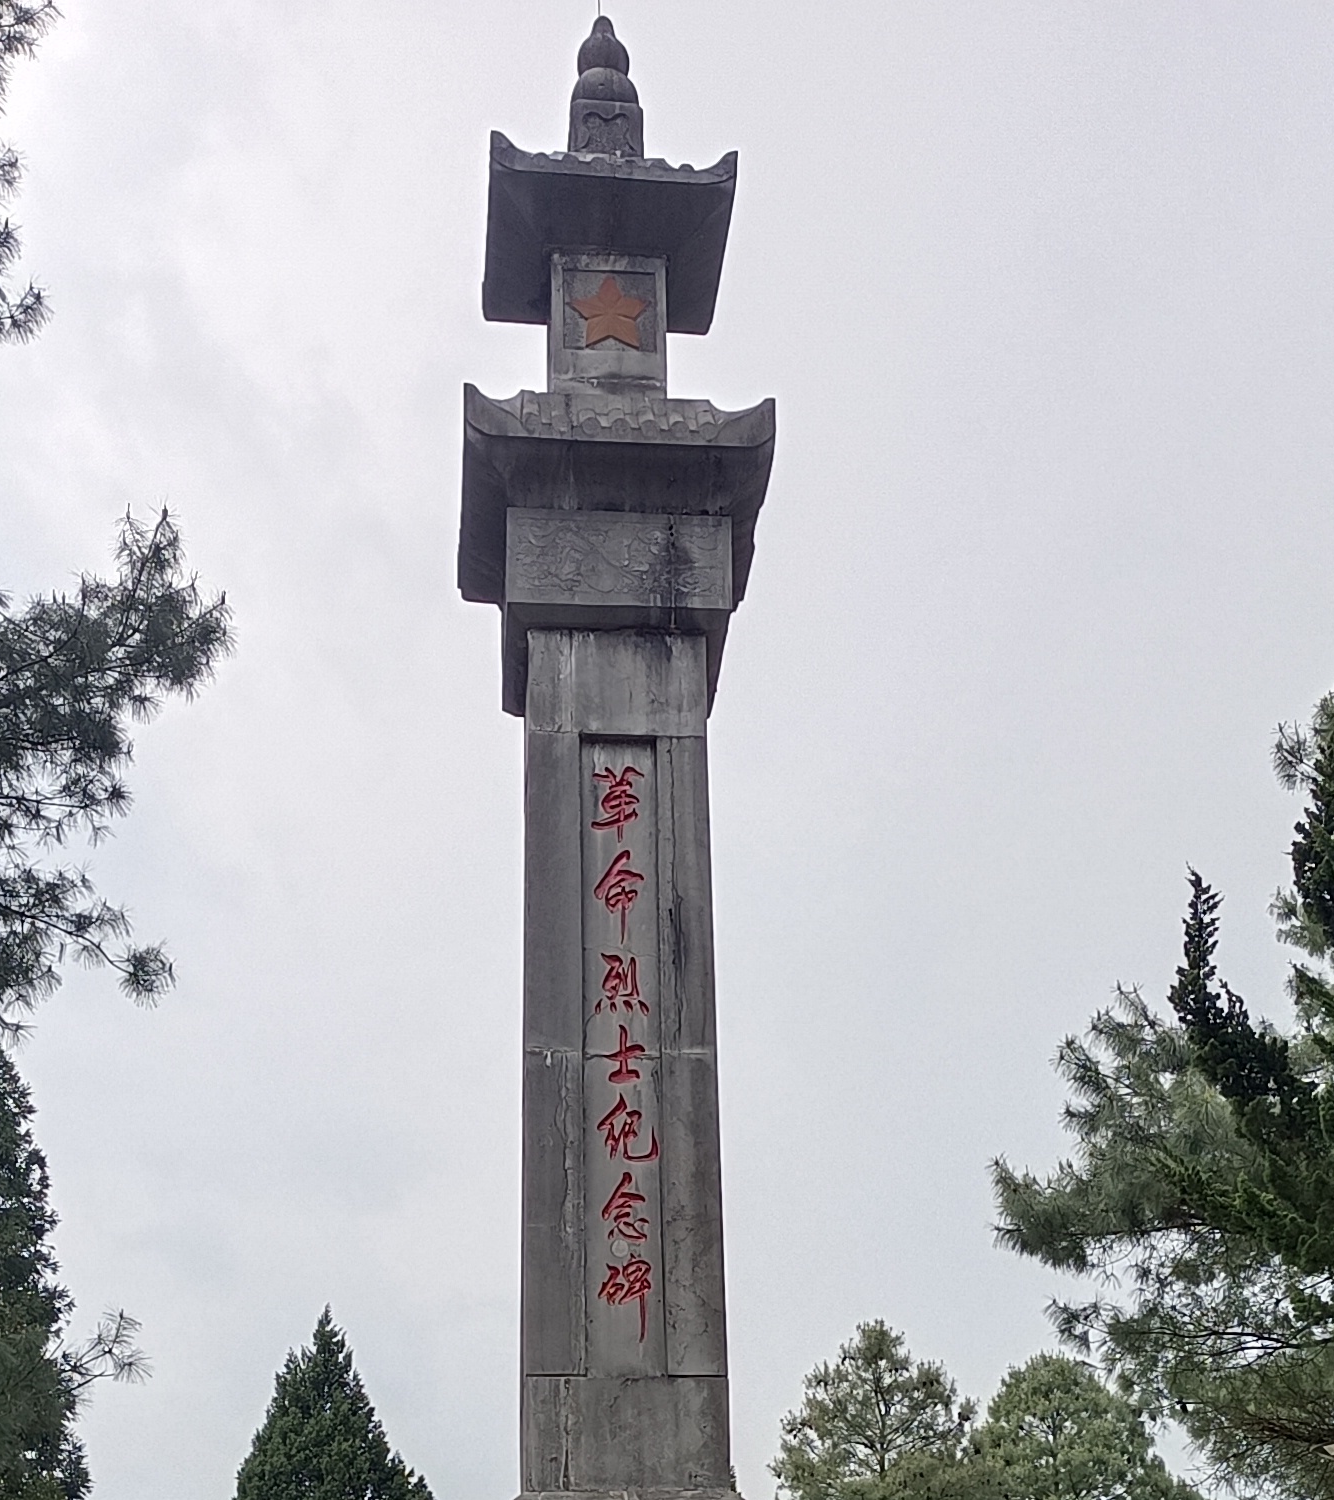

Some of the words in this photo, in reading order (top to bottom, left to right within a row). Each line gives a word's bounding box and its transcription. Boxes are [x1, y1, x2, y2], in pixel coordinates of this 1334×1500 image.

[591, 766, 659, 1342] 革命烈士纪念碑
